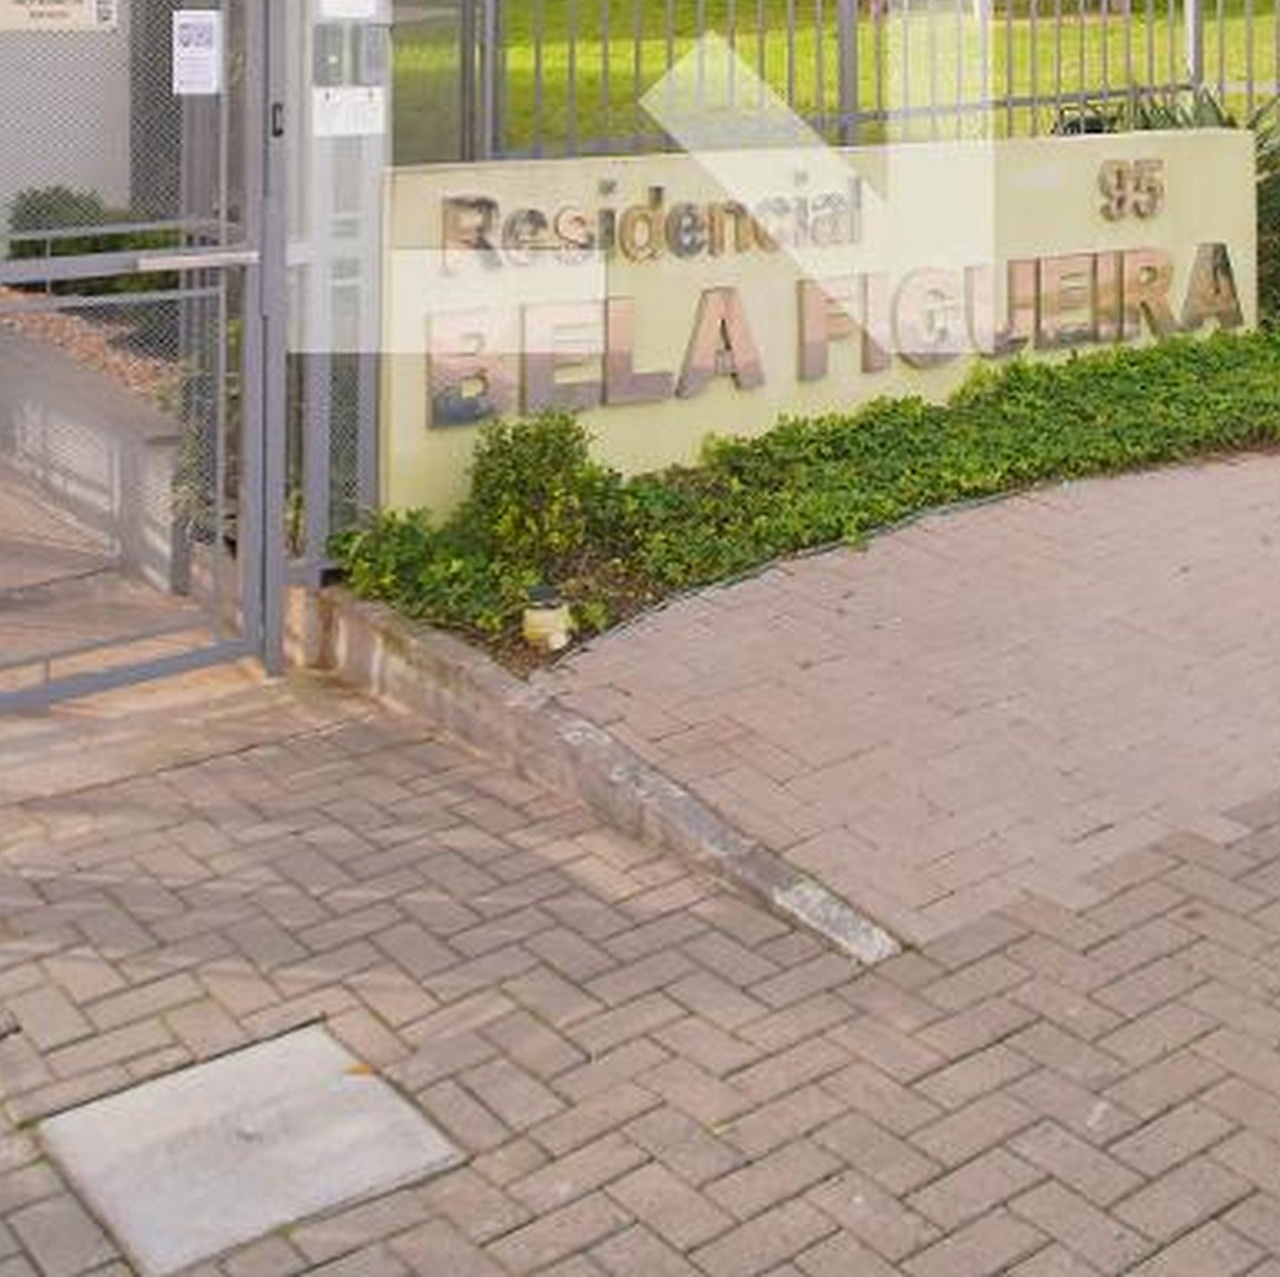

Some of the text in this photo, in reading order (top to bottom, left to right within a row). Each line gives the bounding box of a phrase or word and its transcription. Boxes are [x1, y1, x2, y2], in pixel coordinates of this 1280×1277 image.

[441, 168, 862, 275] Residencial
[1097, 158, 1165, 222] 95
[425, 242, 1245, 428] BELA FIGUEIRA
